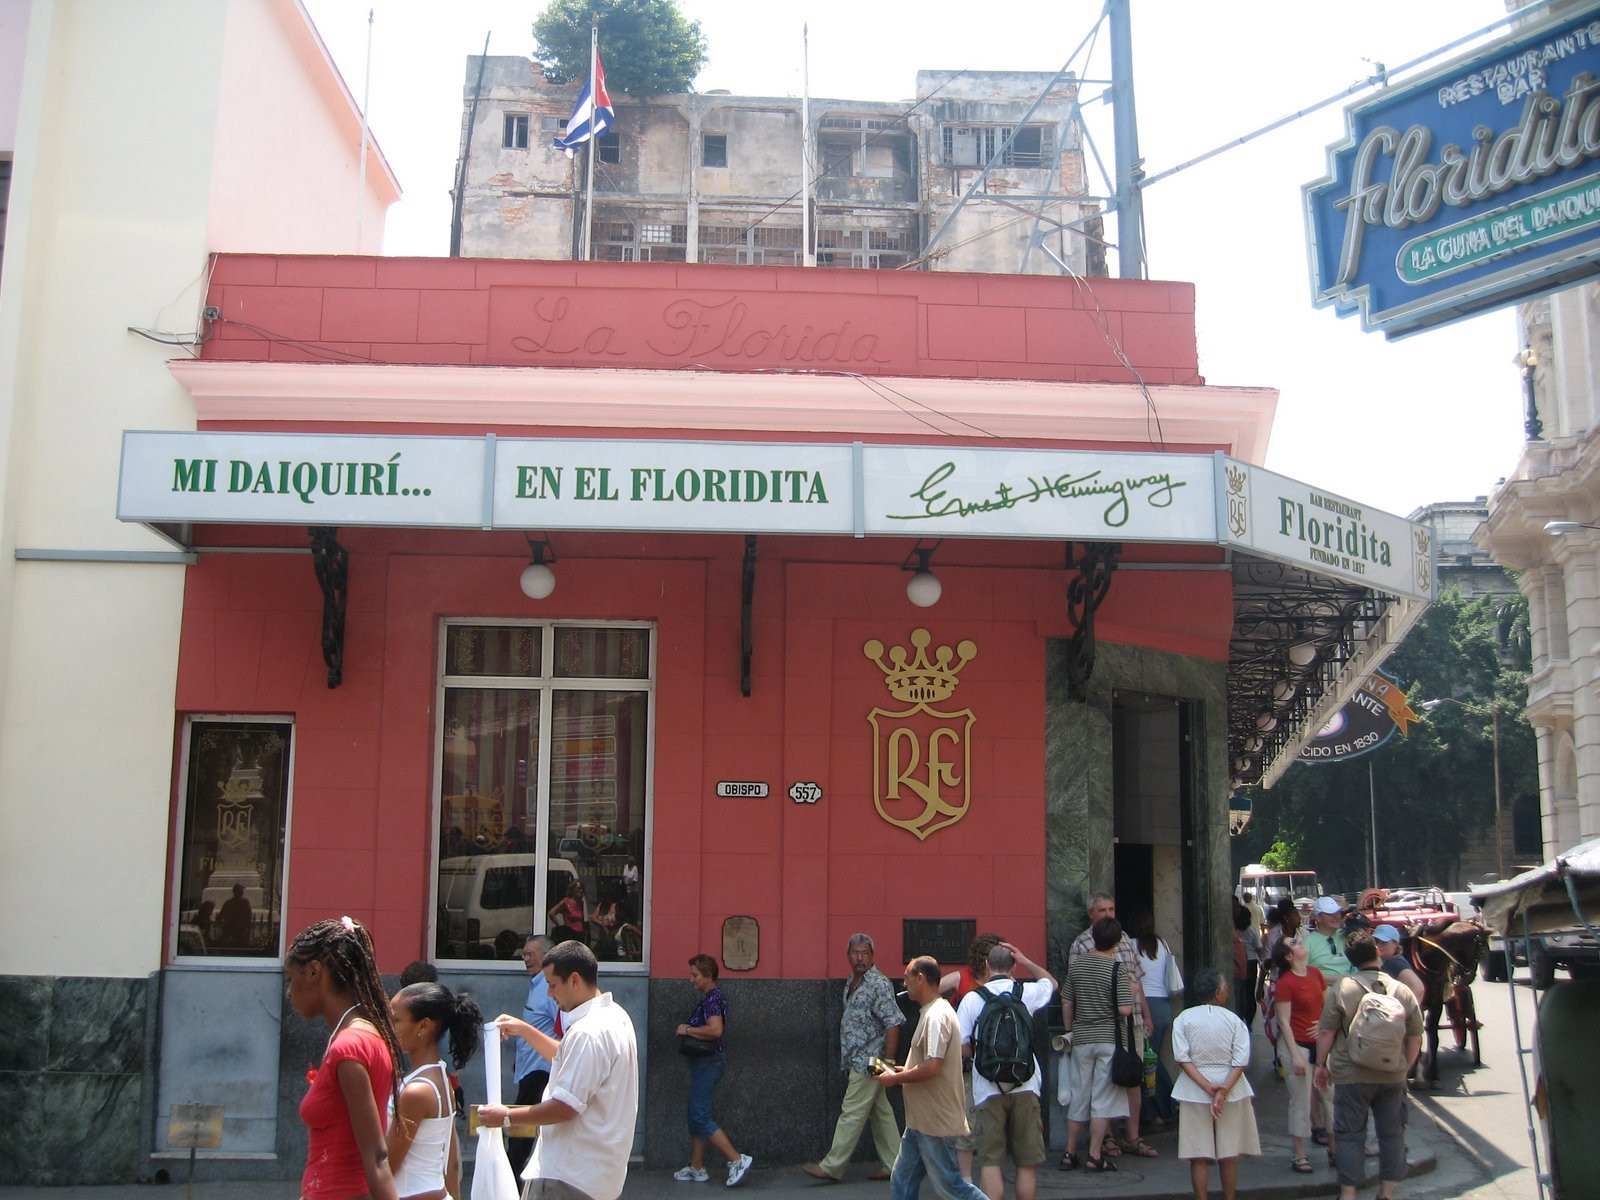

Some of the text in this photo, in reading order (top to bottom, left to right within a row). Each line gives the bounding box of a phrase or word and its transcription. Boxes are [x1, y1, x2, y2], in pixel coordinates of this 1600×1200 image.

[1497, 69, 1546, 105] BAR
[1412, 246, 1436, 272] LA
[1437, 228, 1491, 262] CUNA
[1491, 213, 1532, 246] DEL
[510, 296, 892, 364] La Florida
[171, 452, 432, 504] MI DAIQUIRÍ...
[515, 466, 829, 504] EN EL FLORIDITA
[1018, 470, 1187, 527] Hemingway
[1278, 496, 1391, 567] Floridita
[1309, 547, 1340, 567] FUNDADO
[1341, 556, 1350, 571] EN
[1299, 731, 1379, 757] CIDO EN 1830
[725, 784, 761, 795] OBISPO
[795, 787, 816, 800] 557
